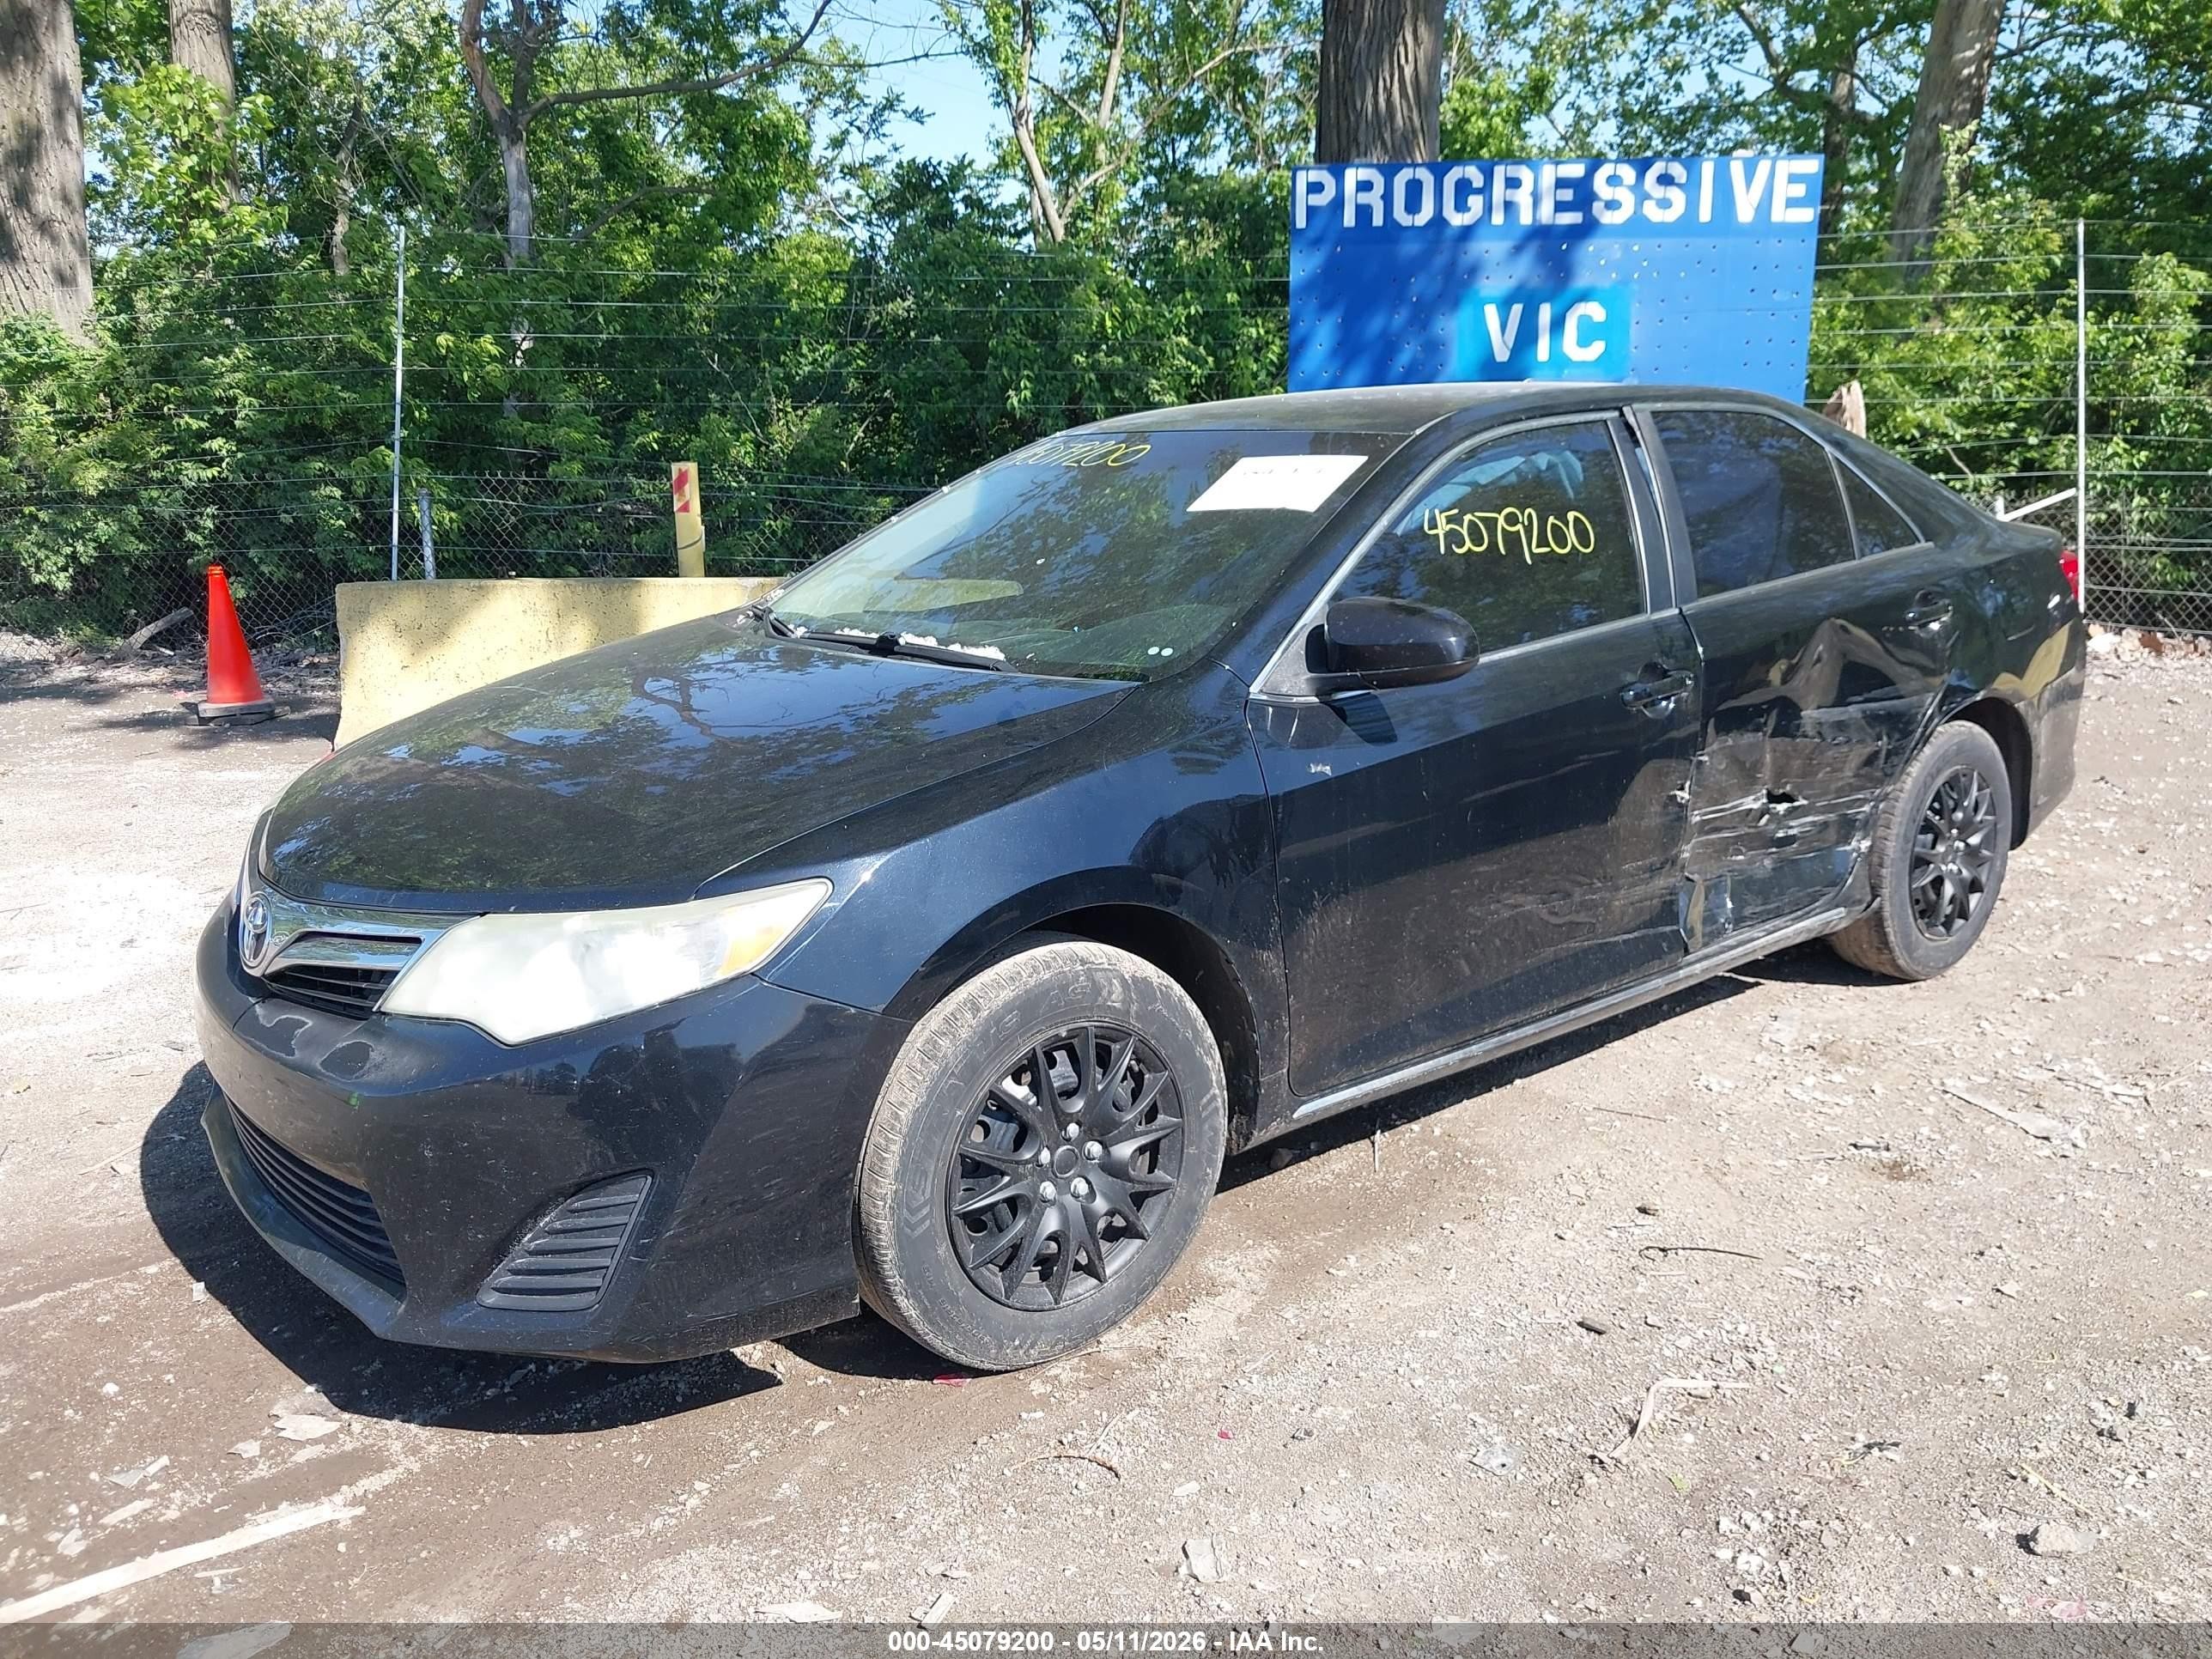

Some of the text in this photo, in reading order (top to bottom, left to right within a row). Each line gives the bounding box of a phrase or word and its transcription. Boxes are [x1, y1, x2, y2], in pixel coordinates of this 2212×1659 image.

[1295, 160, 1819, 228] PROGRESSIVE
[1484, 301, 1607, 362] VIC
[1424, 507, 1595, 565] 45079200
